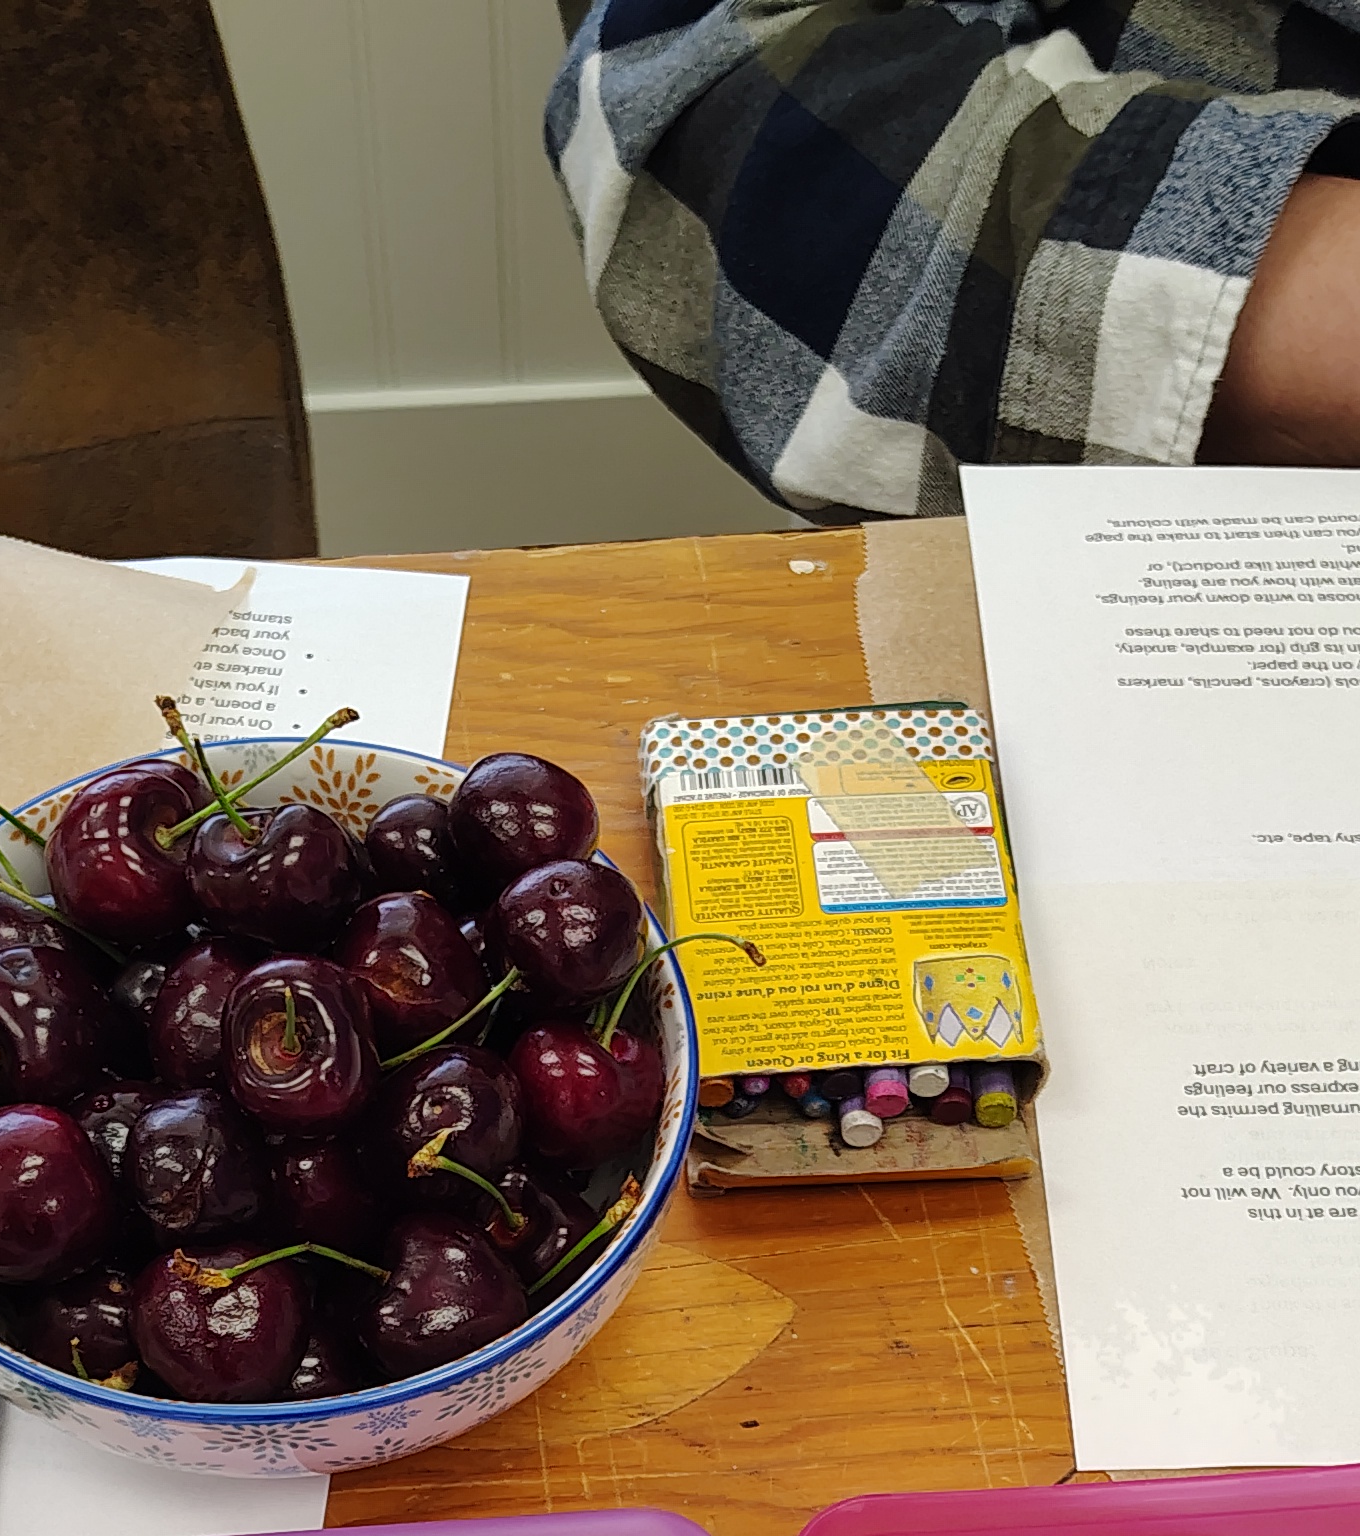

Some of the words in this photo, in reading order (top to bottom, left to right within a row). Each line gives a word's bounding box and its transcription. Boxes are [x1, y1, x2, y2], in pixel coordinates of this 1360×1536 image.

[228, 609, 292, 624] stamps,
[253, 630, 290, 640] your
[201, 643, 240, 654] your
[242, 646, 286, 660] Once
[216, 662, 283, 676] markers
[189, 676, 232, 691] wish,
[235, 682, 265, 692] you
[267, 685, 279, 696] If
[195, 697, 206, 706] a
[210, 696, 262, 710] poem,
[266, 703, 276, 711] a
[206, 716, 244, 726] your
[248, 719, 272, 730] On
[797, 1055, 814, 1063] or
[816, 1052, 851, 1064] King
[853, 1051, 863, 1059] a
[866, 1050, 888, 1061] for
[889, 1049, 910, 1060] Fit
[746, 1055, 795, 1068] Queen
[1247, 1208, 1282, 1221] this
[1285, 1208, 1304, 1221] in
[1305, 1208, 1325, 1219] at
[1328, 1207, 1358, 1218] are
